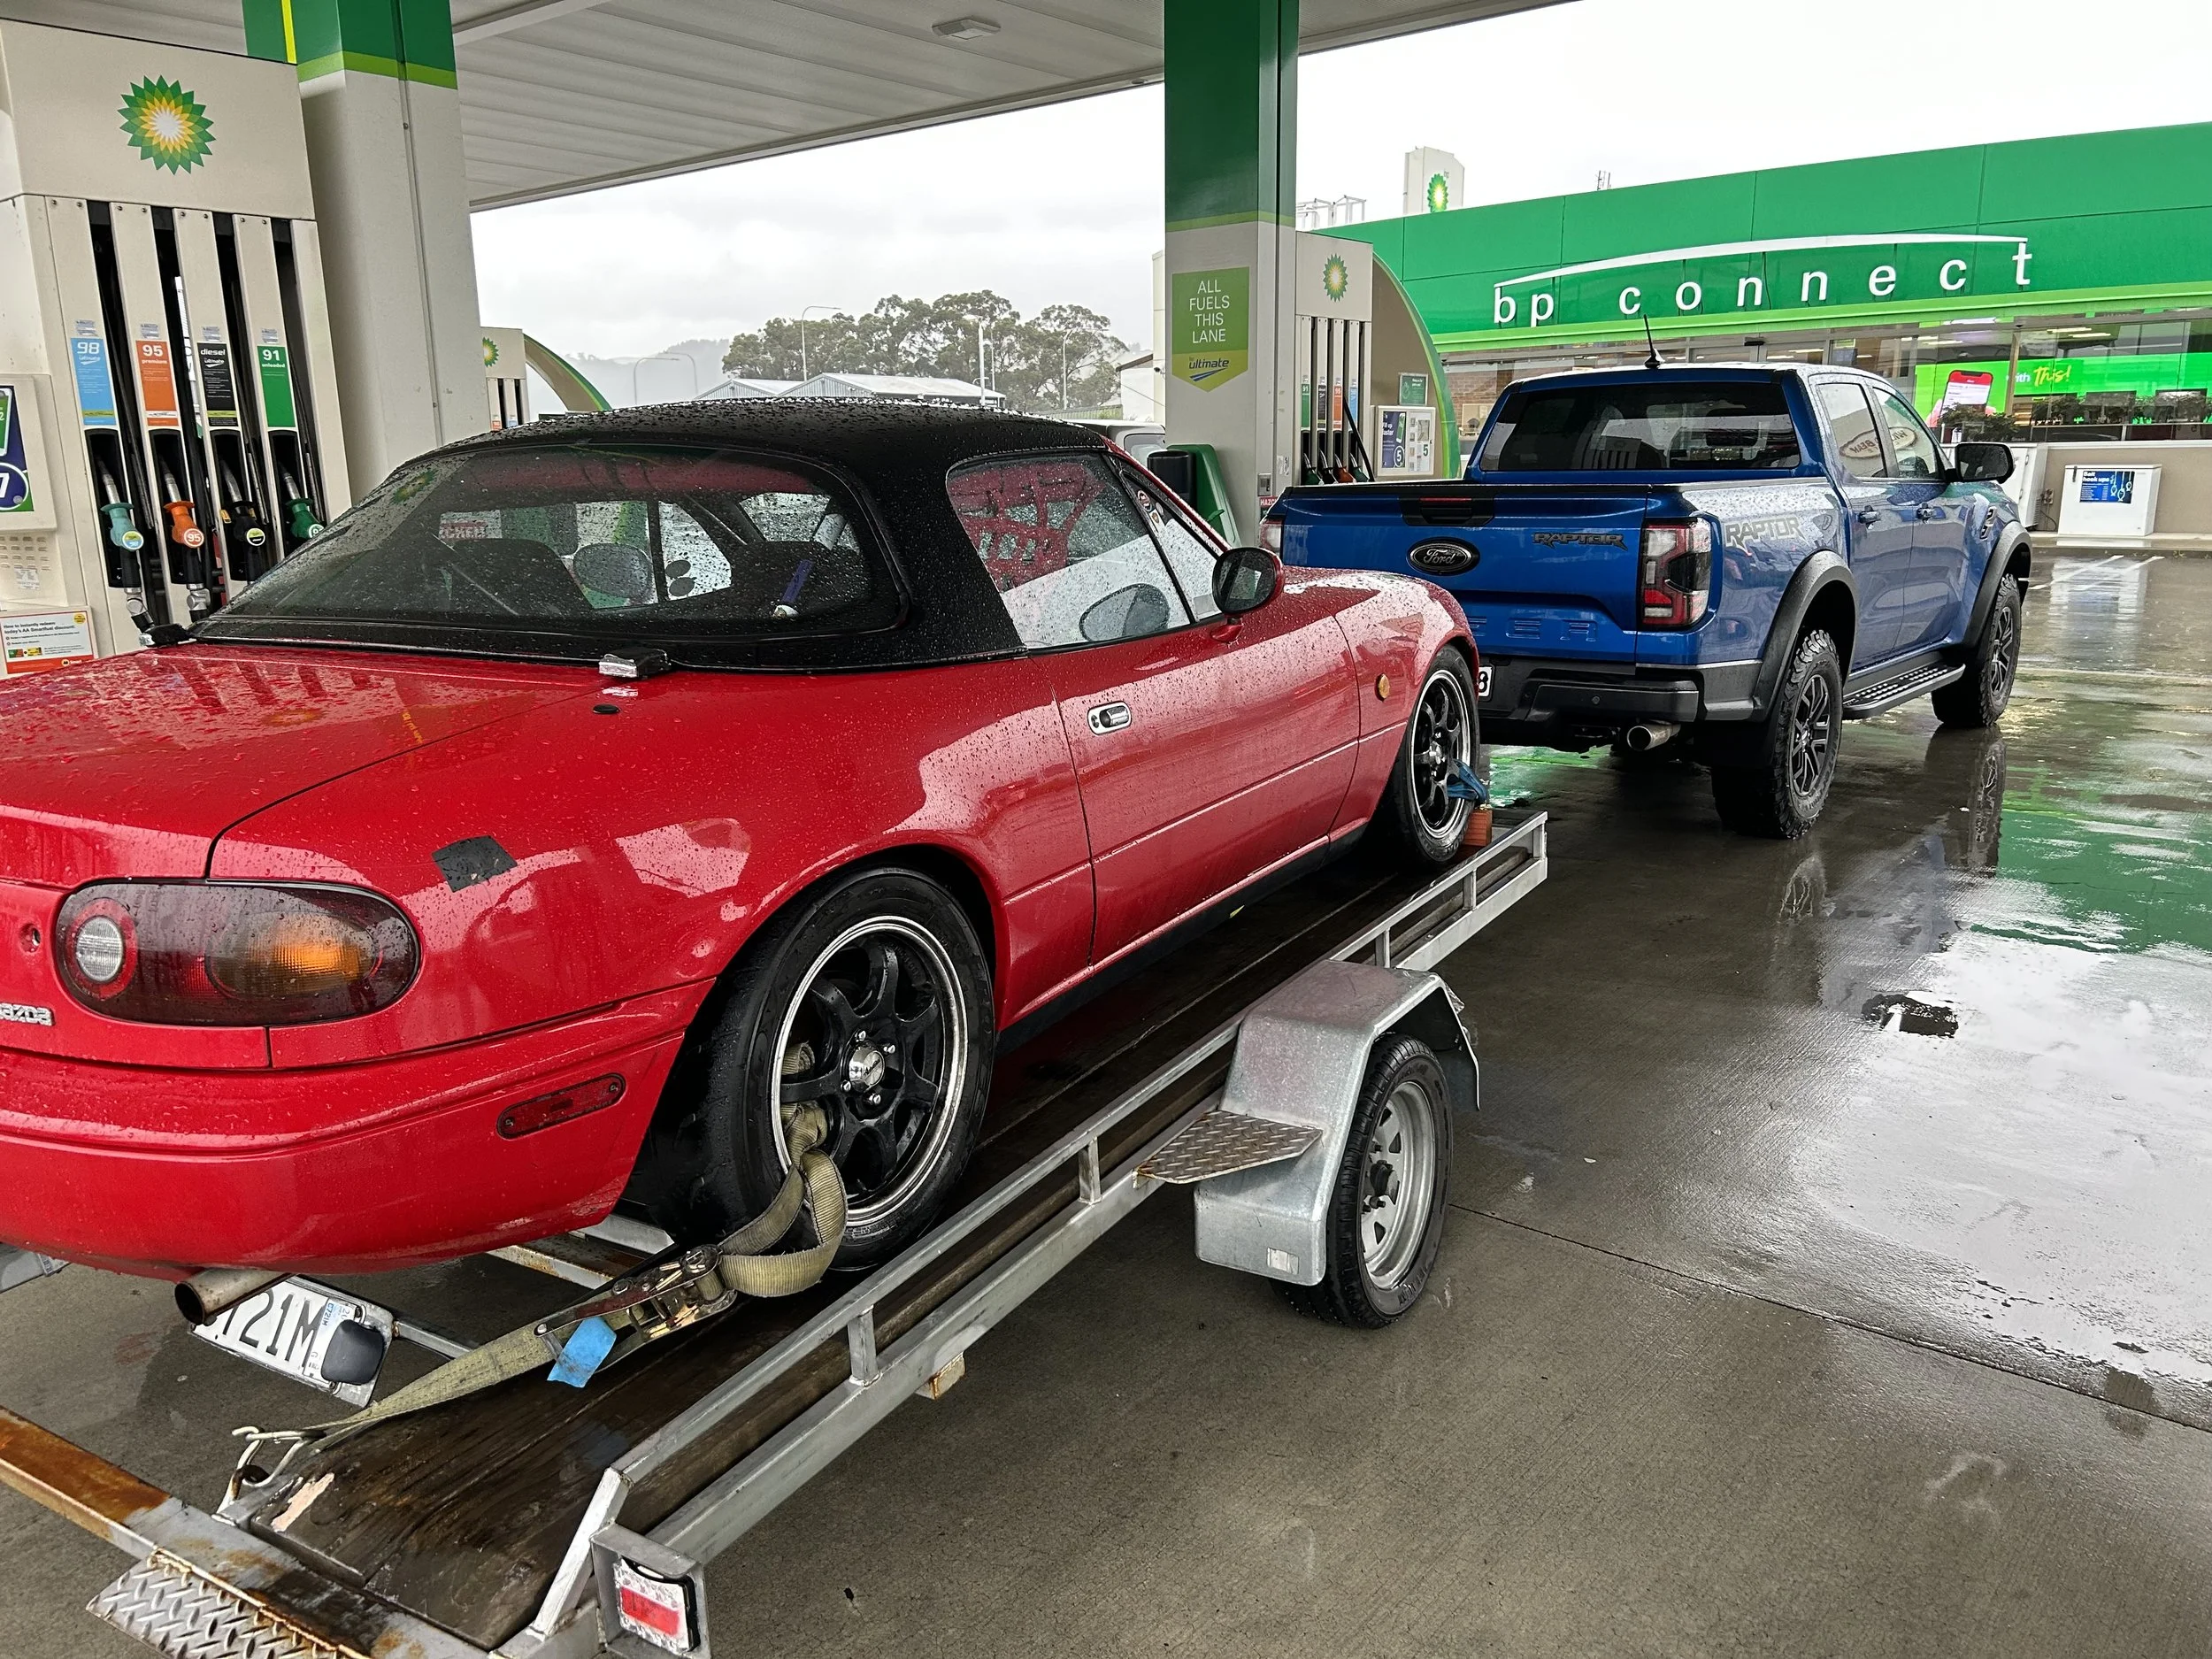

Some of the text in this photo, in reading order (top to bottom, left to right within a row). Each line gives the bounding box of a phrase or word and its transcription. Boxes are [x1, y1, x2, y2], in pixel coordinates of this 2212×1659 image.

[1197, 279, 1222, 295] ALL
[1494, 241, 2031, 327] bp connect
[1189, 295, 1230, 311] FUELS
[1194, 312, 1224, 327] THIS
[1192, 328, 1226, 344] LANE
[77, 342, 100, 355] 98
[142, 344, 163, 357] 95
[262, 349, 280, 361] 91
[1188, 357, 1230, 370] ultimate
[2033, 365, 2072, 388] This!
[1396, 449, 1402, 462] 5
[1423, 443, 1429, 457] 5
[188, 533, 202, 542] 95
[1532, 532, 1629, 551] RAPTOR
[1724, 517, 1810, 556] RAPTOR
[1423, 548, 1457, 565] Ford
